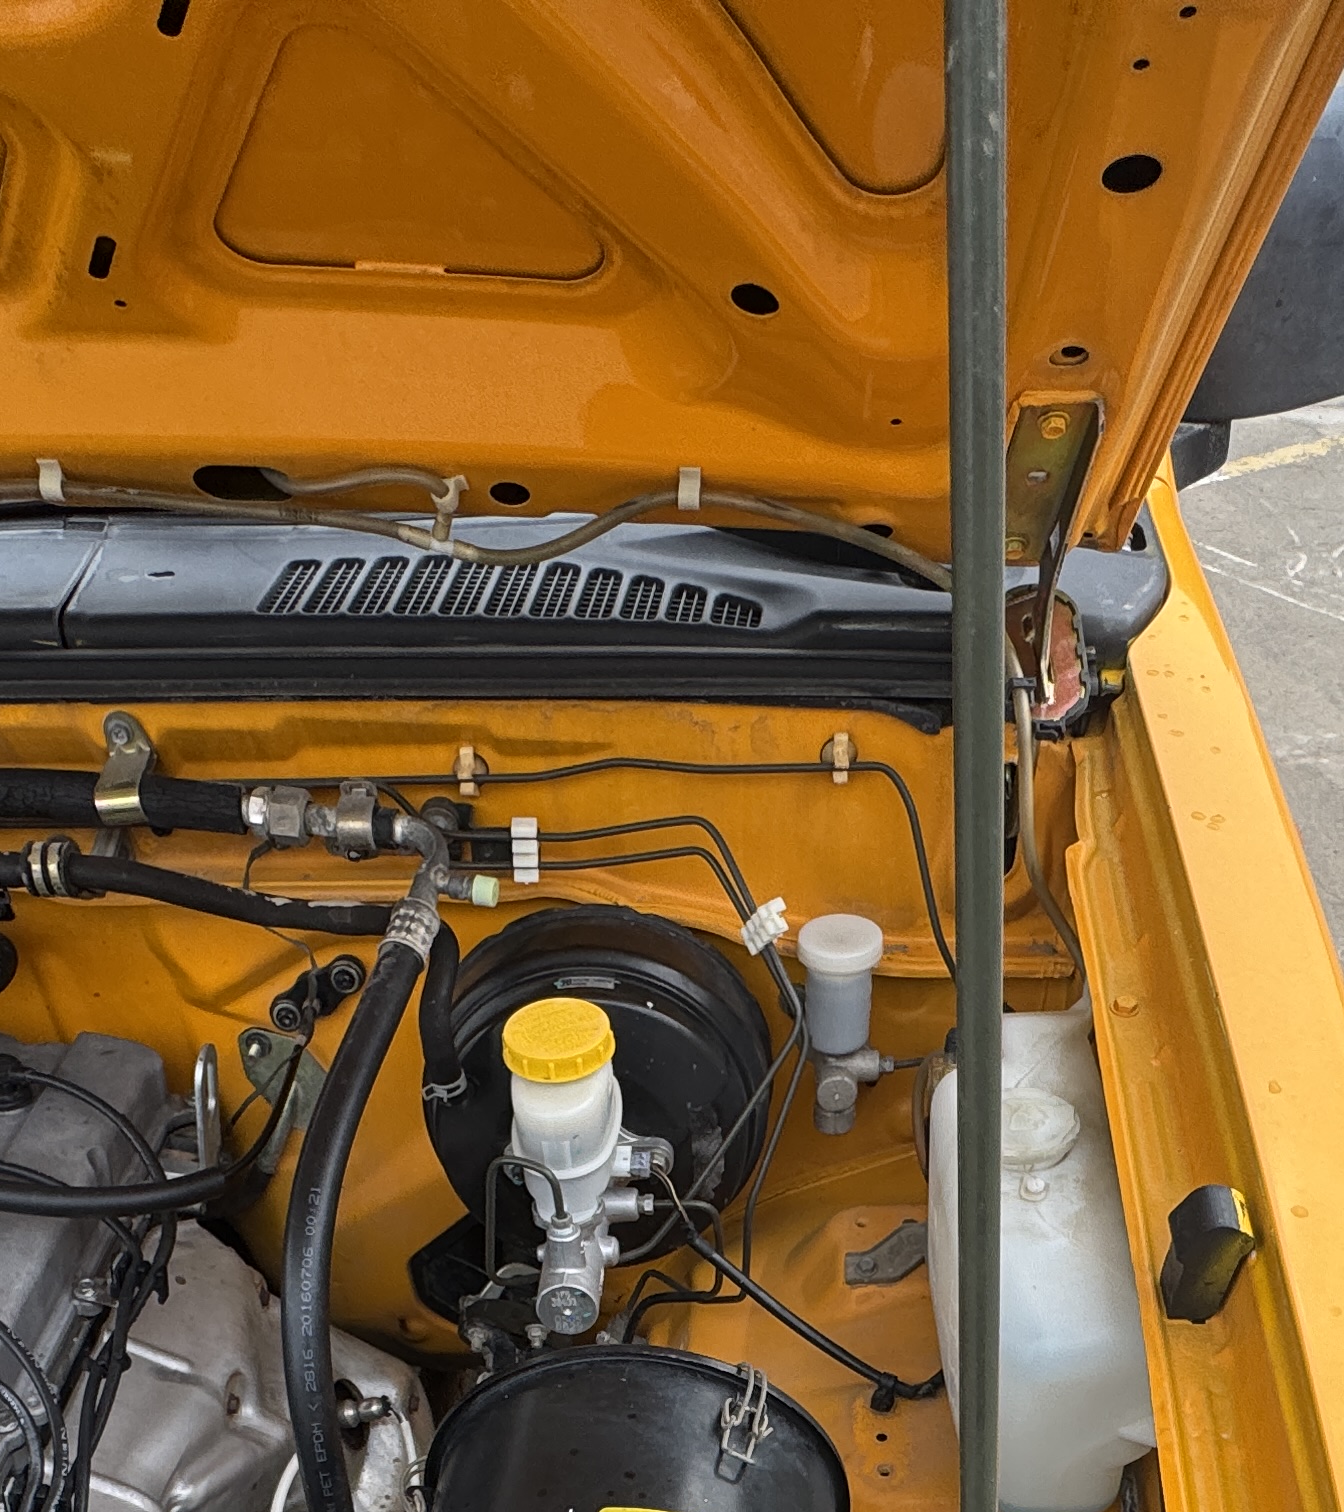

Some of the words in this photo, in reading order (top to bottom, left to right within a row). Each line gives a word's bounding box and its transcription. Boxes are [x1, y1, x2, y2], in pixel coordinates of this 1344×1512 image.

[301, 1247, 314, 1336] 20160706
[305, 1349, 317, 1392] 2816
[311, 1422, 327, 1463] EPDM
[319, 1471, 334, 1497] PET
